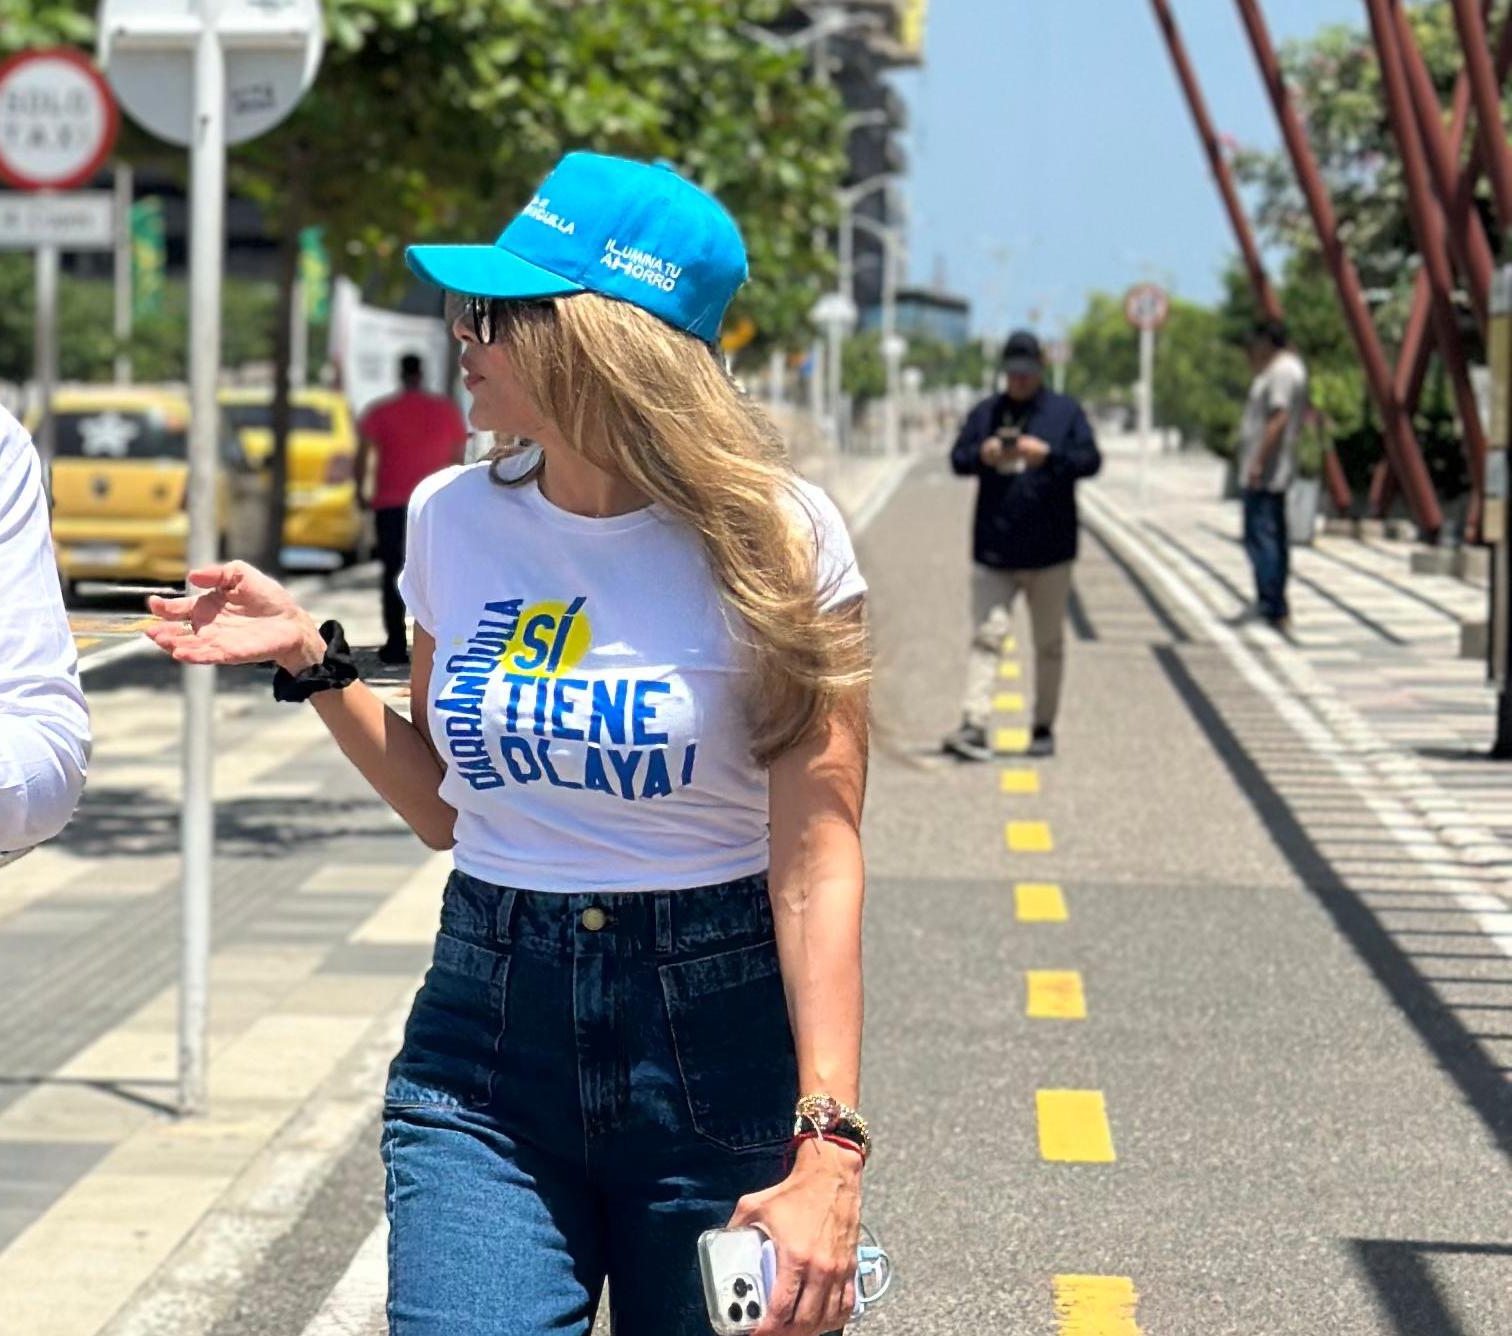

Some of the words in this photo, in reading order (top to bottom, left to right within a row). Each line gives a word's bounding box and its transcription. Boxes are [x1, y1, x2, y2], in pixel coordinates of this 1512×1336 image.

[6, 88, 88, 117] SOLO
[4, 121, 89, 150] TAXI
[600, 253, 675, 292] AHORRO
[605, 238, 663, 272] ILUMINA
[665, 262, 683, 279] TU
[514, 596, 587, 673] SÍ
[501, 672, 671, 745] TIENE
